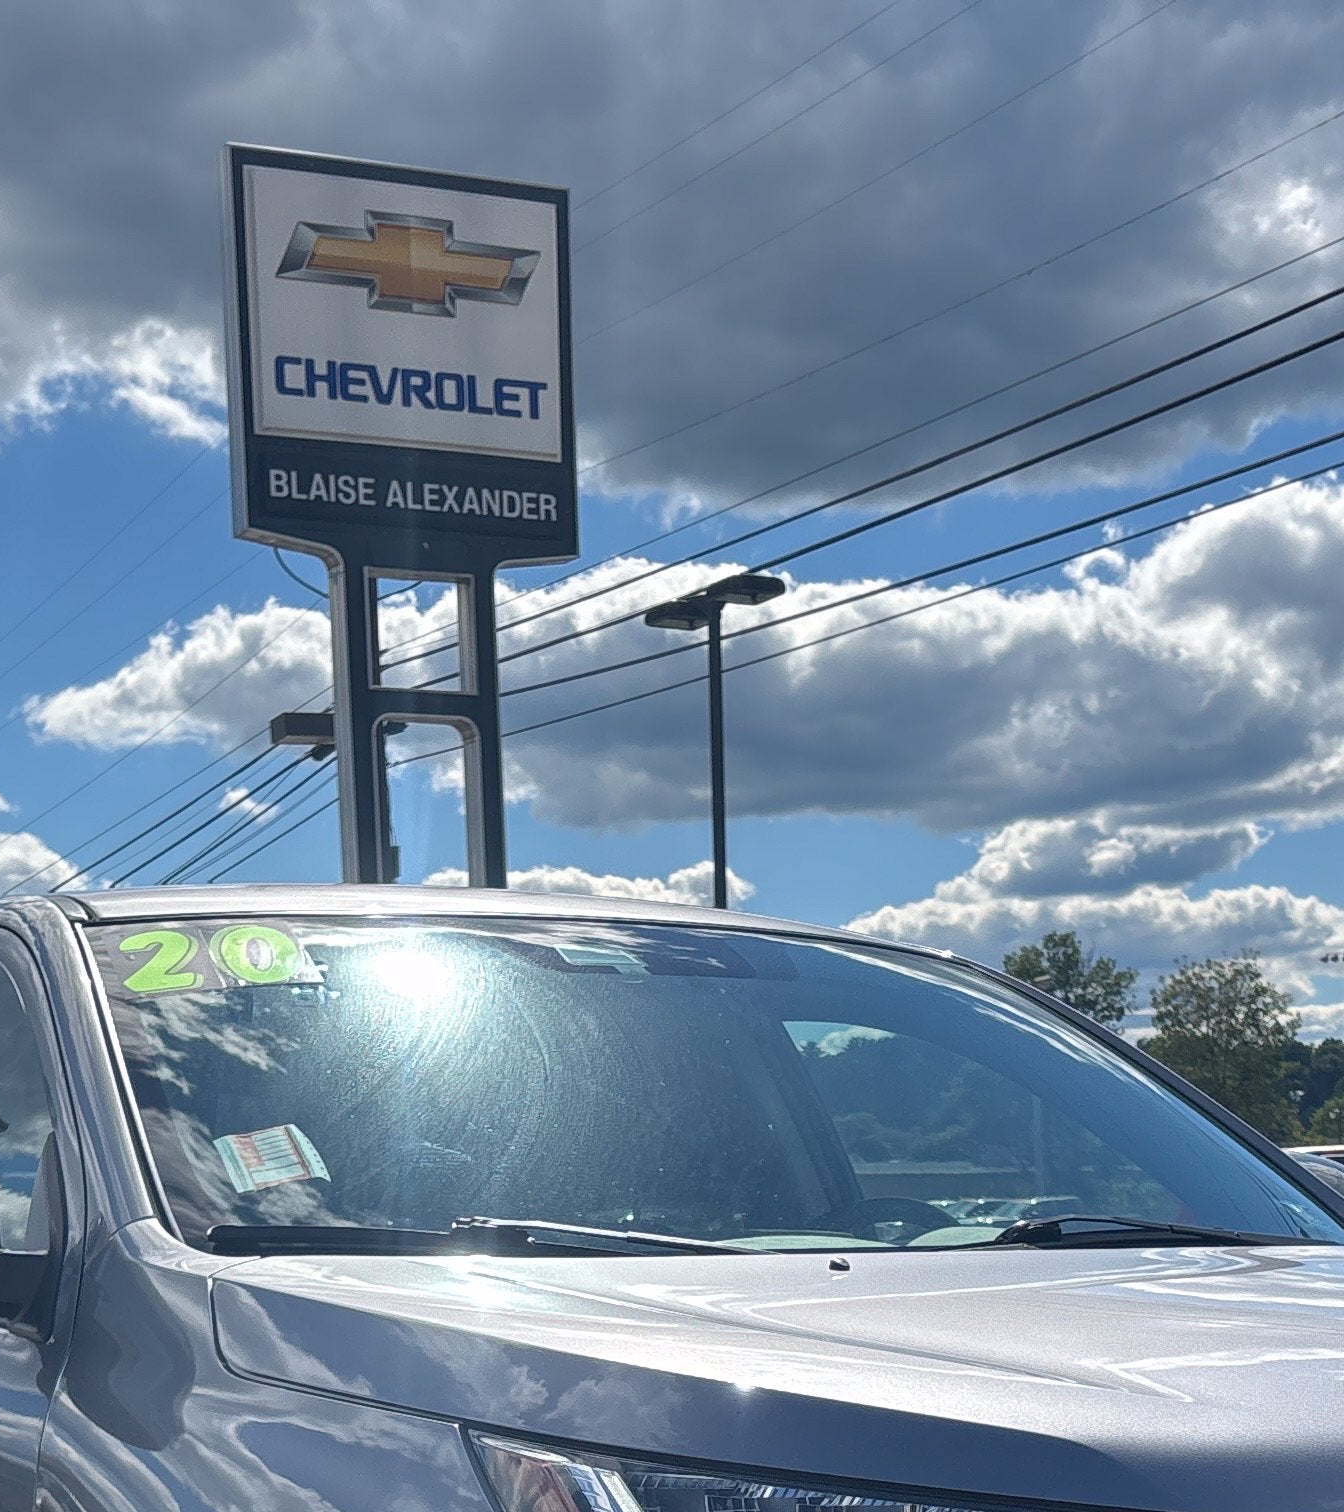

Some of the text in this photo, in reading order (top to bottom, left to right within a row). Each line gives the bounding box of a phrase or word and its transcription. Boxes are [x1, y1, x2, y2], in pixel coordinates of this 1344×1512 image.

[275, 355, 547, 419] CHEVROLET
[269, 468, 558, 521] BLAISE ALEXANDER
[119, 924, 300, 993] 20
